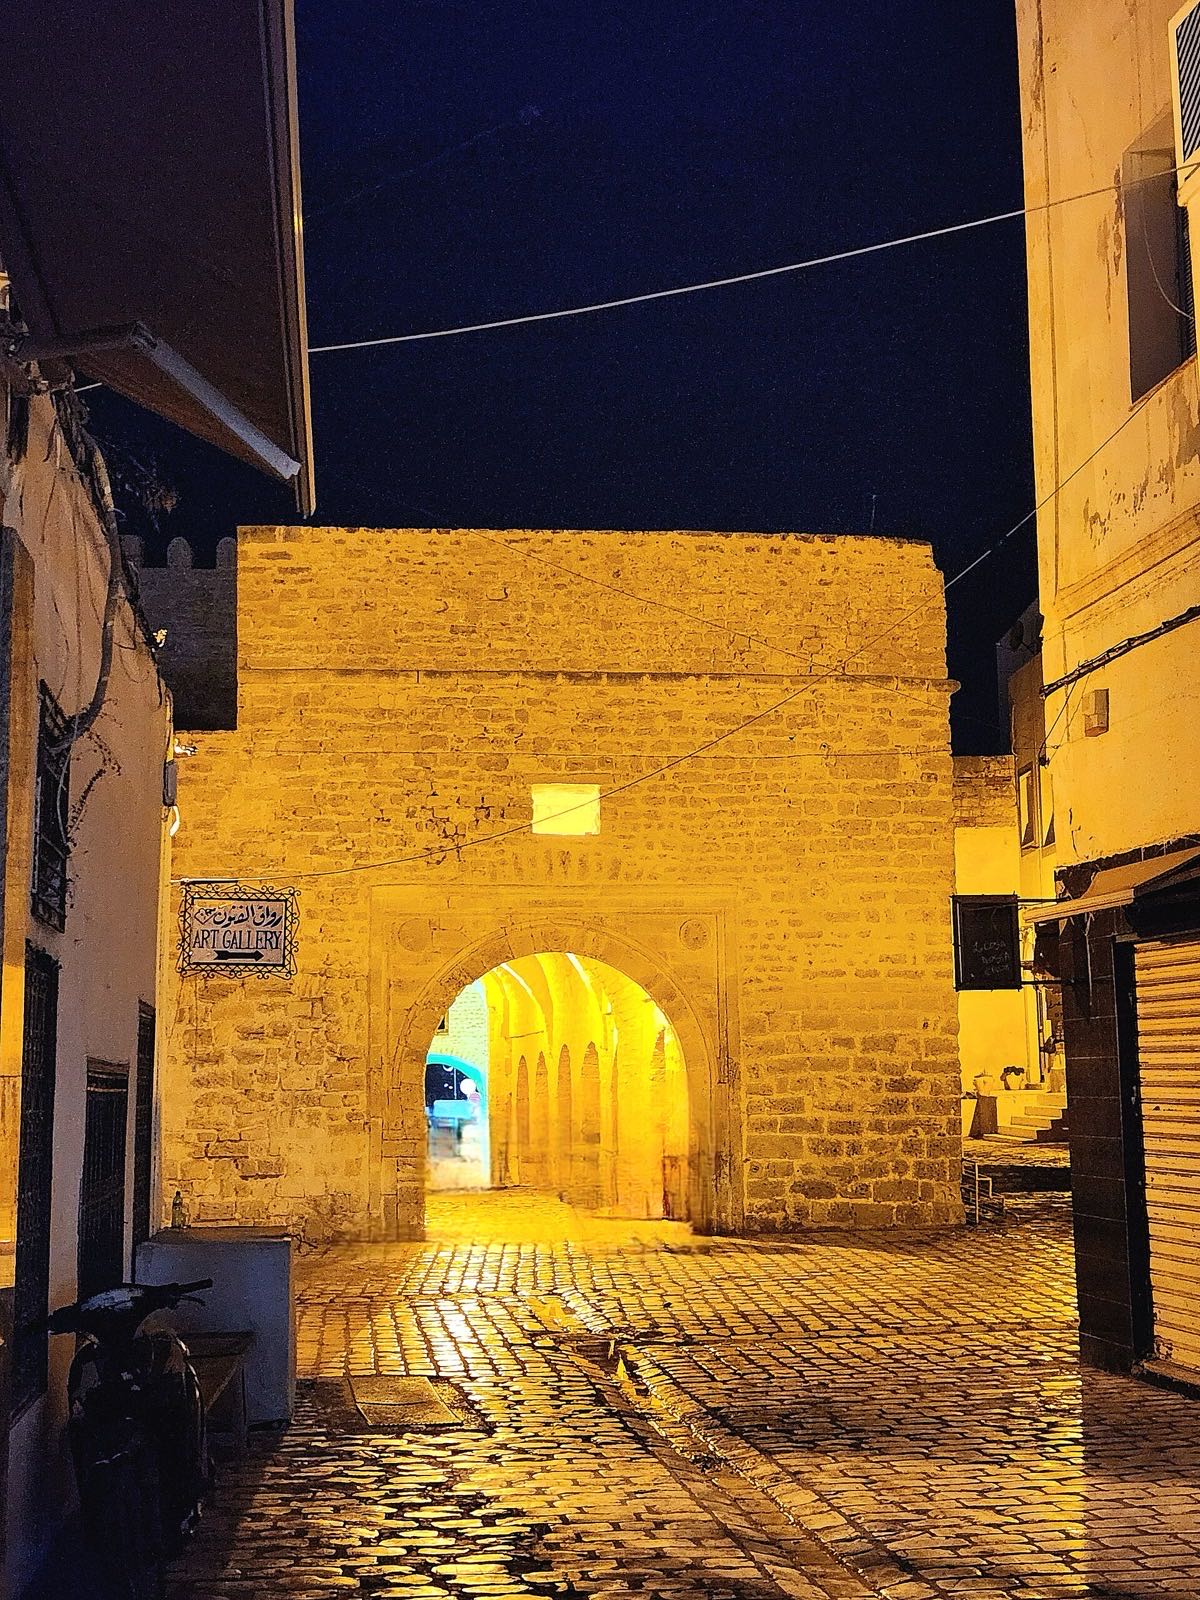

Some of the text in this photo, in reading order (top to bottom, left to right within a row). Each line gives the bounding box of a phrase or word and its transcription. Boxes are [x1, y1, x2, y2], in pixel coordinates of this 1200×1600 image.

[213, 904, 255, 928] الفنون
[253, 904, 283, 928] رواق
[192, 929, 282, 950] ART GALLERY
